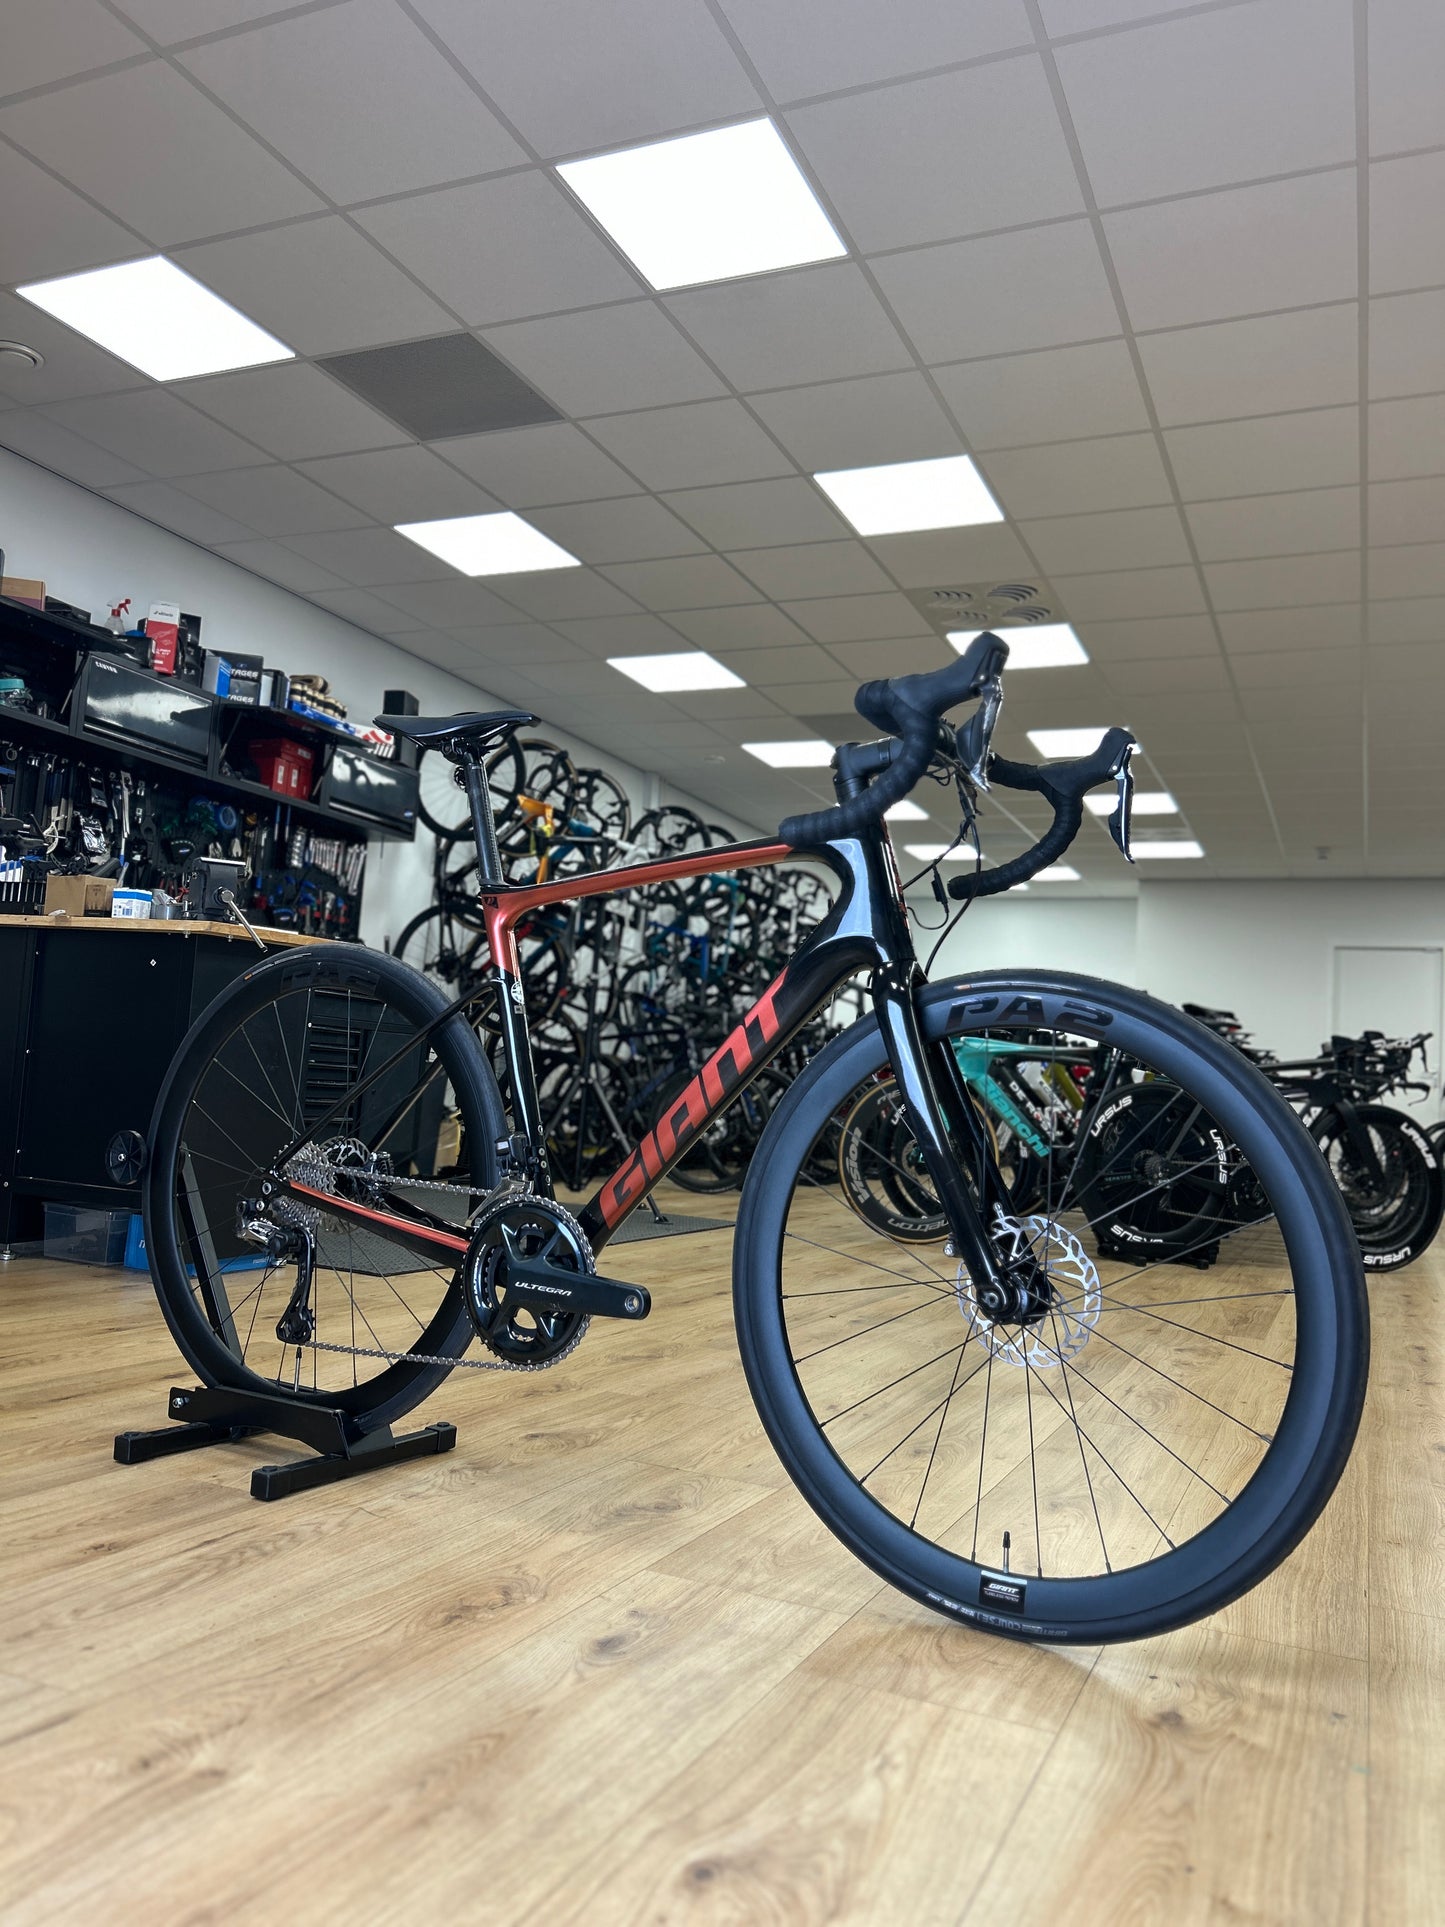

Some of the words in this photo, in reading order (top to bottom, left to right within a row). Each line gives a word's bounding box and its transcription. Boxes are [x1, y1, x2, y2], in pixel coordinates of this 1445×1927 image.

[229, 668, 259, 678] TAGES
[600, 965, 792, 1229] GIANT
[1009, 1080, 1026, 1101] DE
[1090, 1095, 1132, 1137] URSUS
[1400, 1121, 1437, 1169] URSUS
[1209, 1129, 1228, 1184] URSUS
[1363, 1246, 1411, 1265] URSUS
[514, 1281, 573, 1297] ULTEGRA
[988, 1583, 1019, 1594] GIANT
